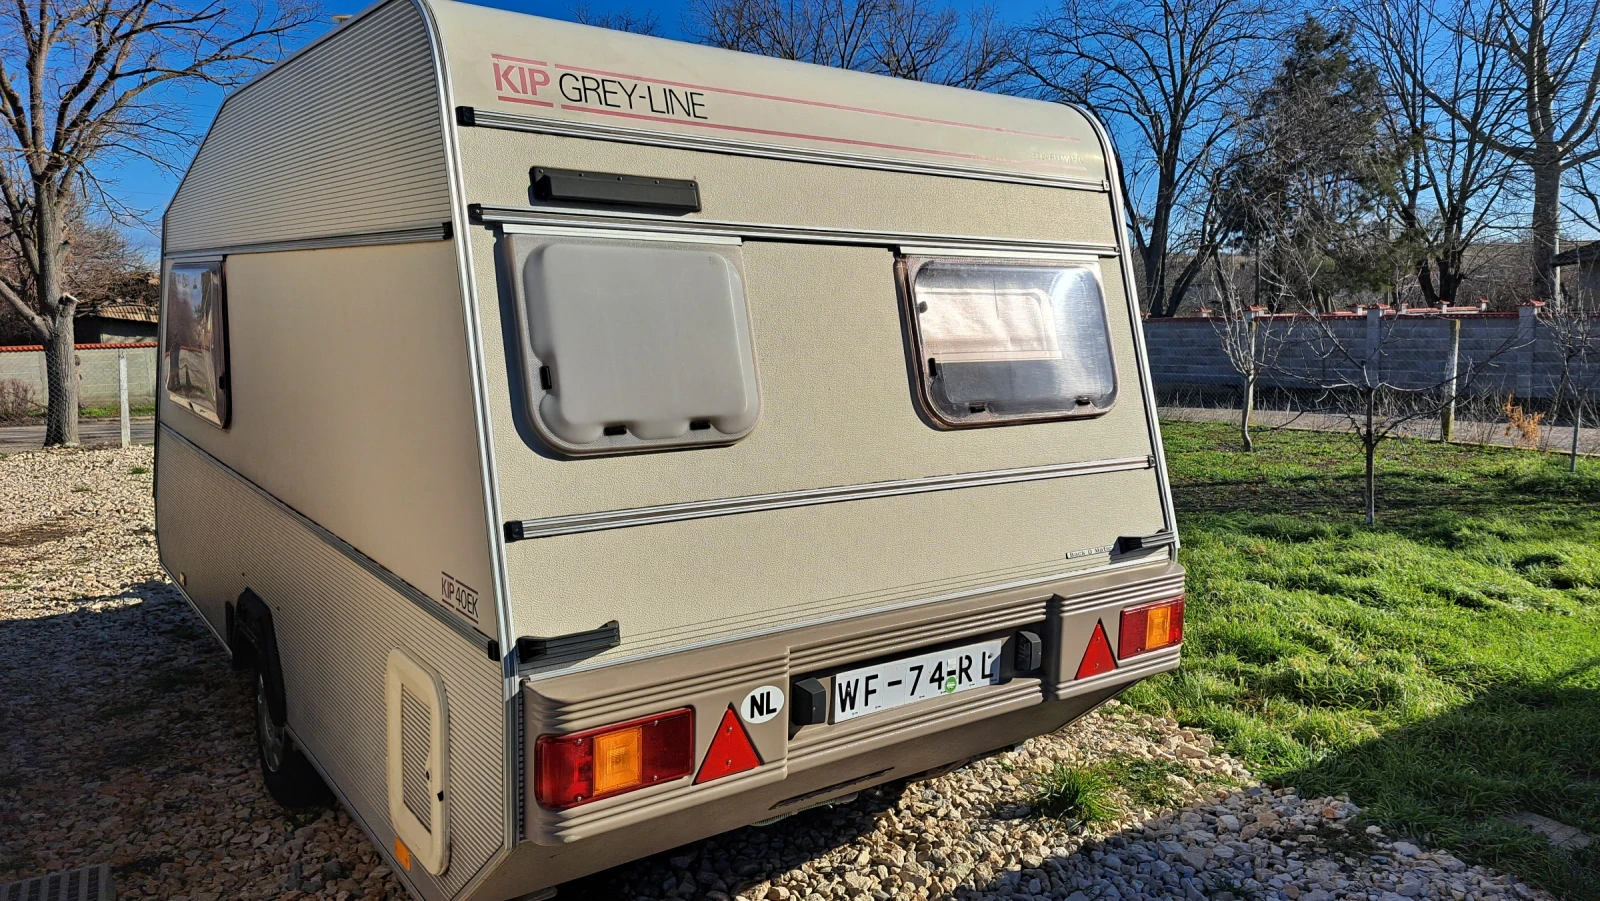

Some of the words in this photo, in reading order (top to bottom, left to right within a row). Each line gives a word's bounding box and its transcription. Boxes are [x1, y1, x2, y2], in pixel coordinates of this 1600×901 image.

[492, 62, 550, 96] KIP
[559, 73, 708, 119] GREY-LINE
[441, 577, 454, 600] KIP
[455, 587, 478, 618] 40EK
[750, 691, 777, 719] NL
[838, 651, 994, 713] WF-74-RL
